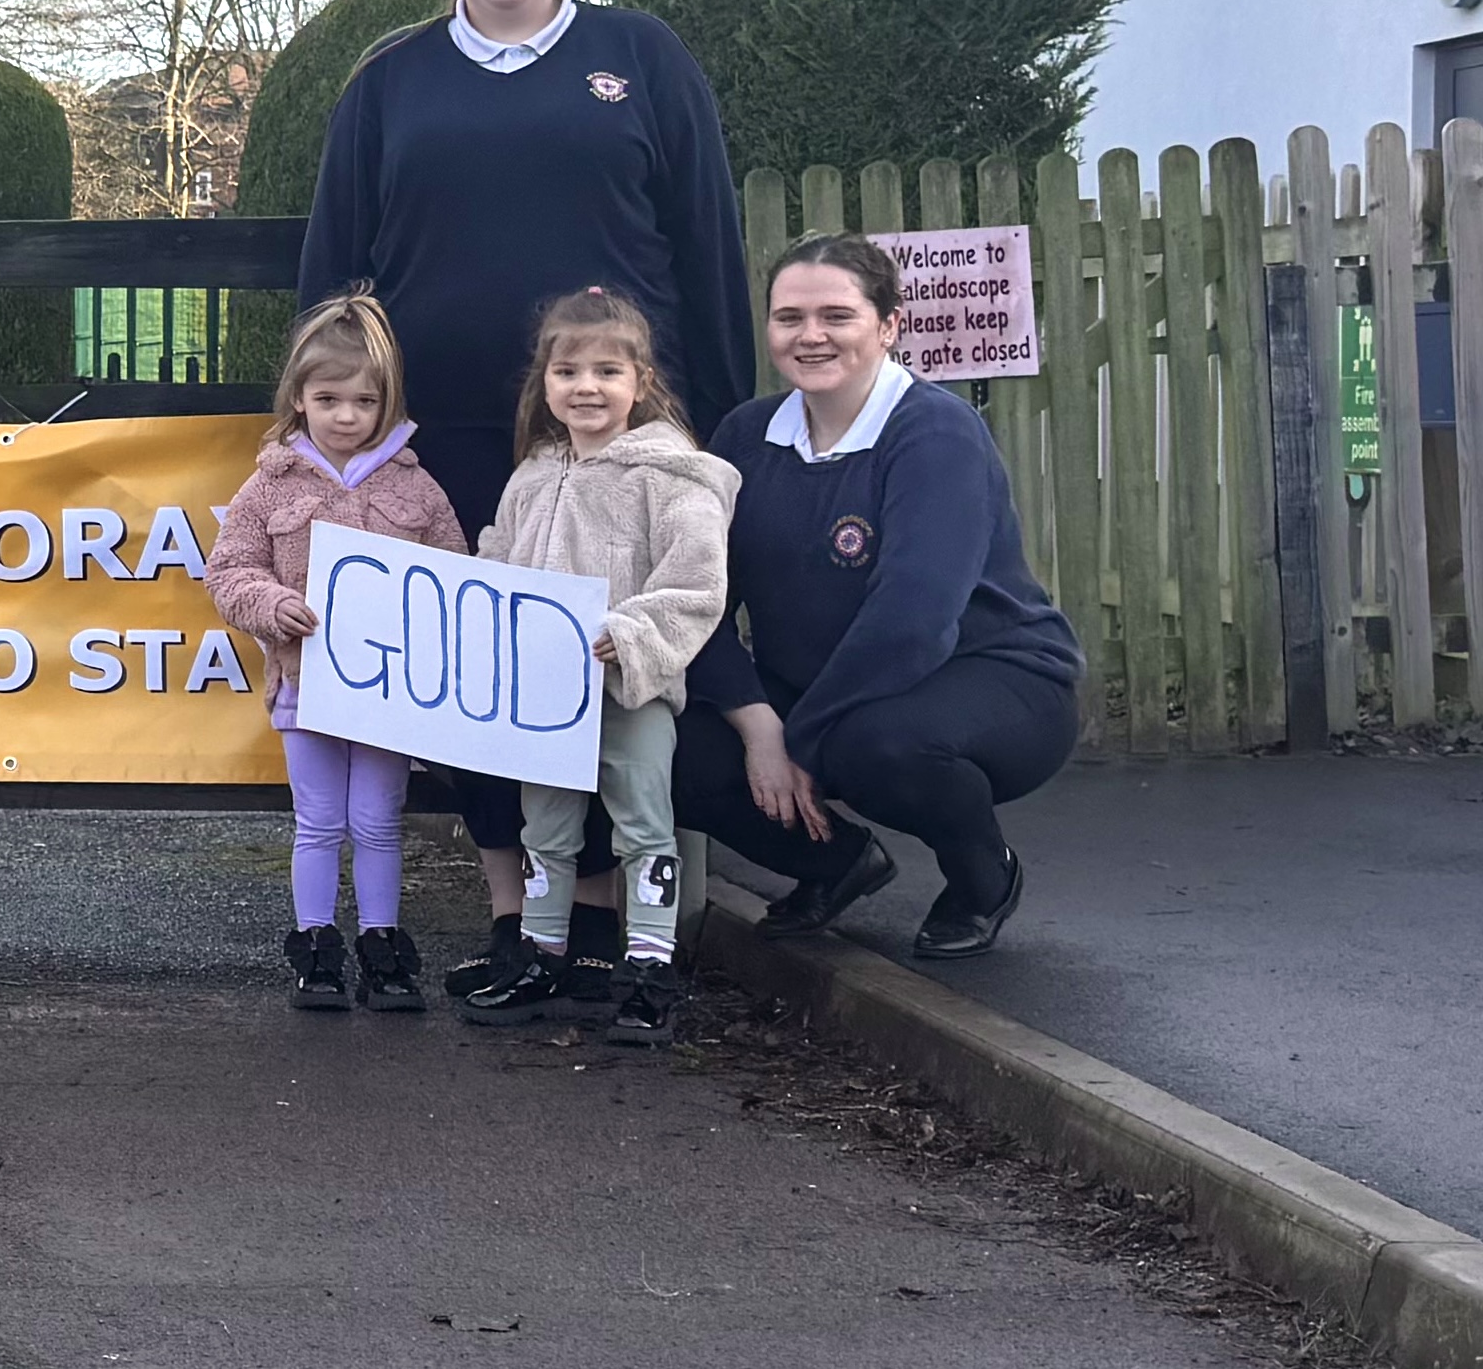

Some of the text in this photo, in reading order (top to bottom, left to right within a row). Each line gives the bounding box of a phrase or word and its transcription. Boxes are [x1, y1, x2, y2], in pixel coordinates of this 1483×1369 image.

[891, 242, 1006, 270] Welcome to
[902, 276, 1011, 304] aleidoscope
[898, 306, 1009, 341] please keep
[921, 343, 963, 373] gate
[971, 335, 1031, 364] closed
[1355, 384, 1375, 405] Fire
[1341, 412, 1380, 432] assemb
[1351, 438, 1379, 463] point
[325, 554, 592, 733] GOOD
[69, 627, 265, 694] STA
